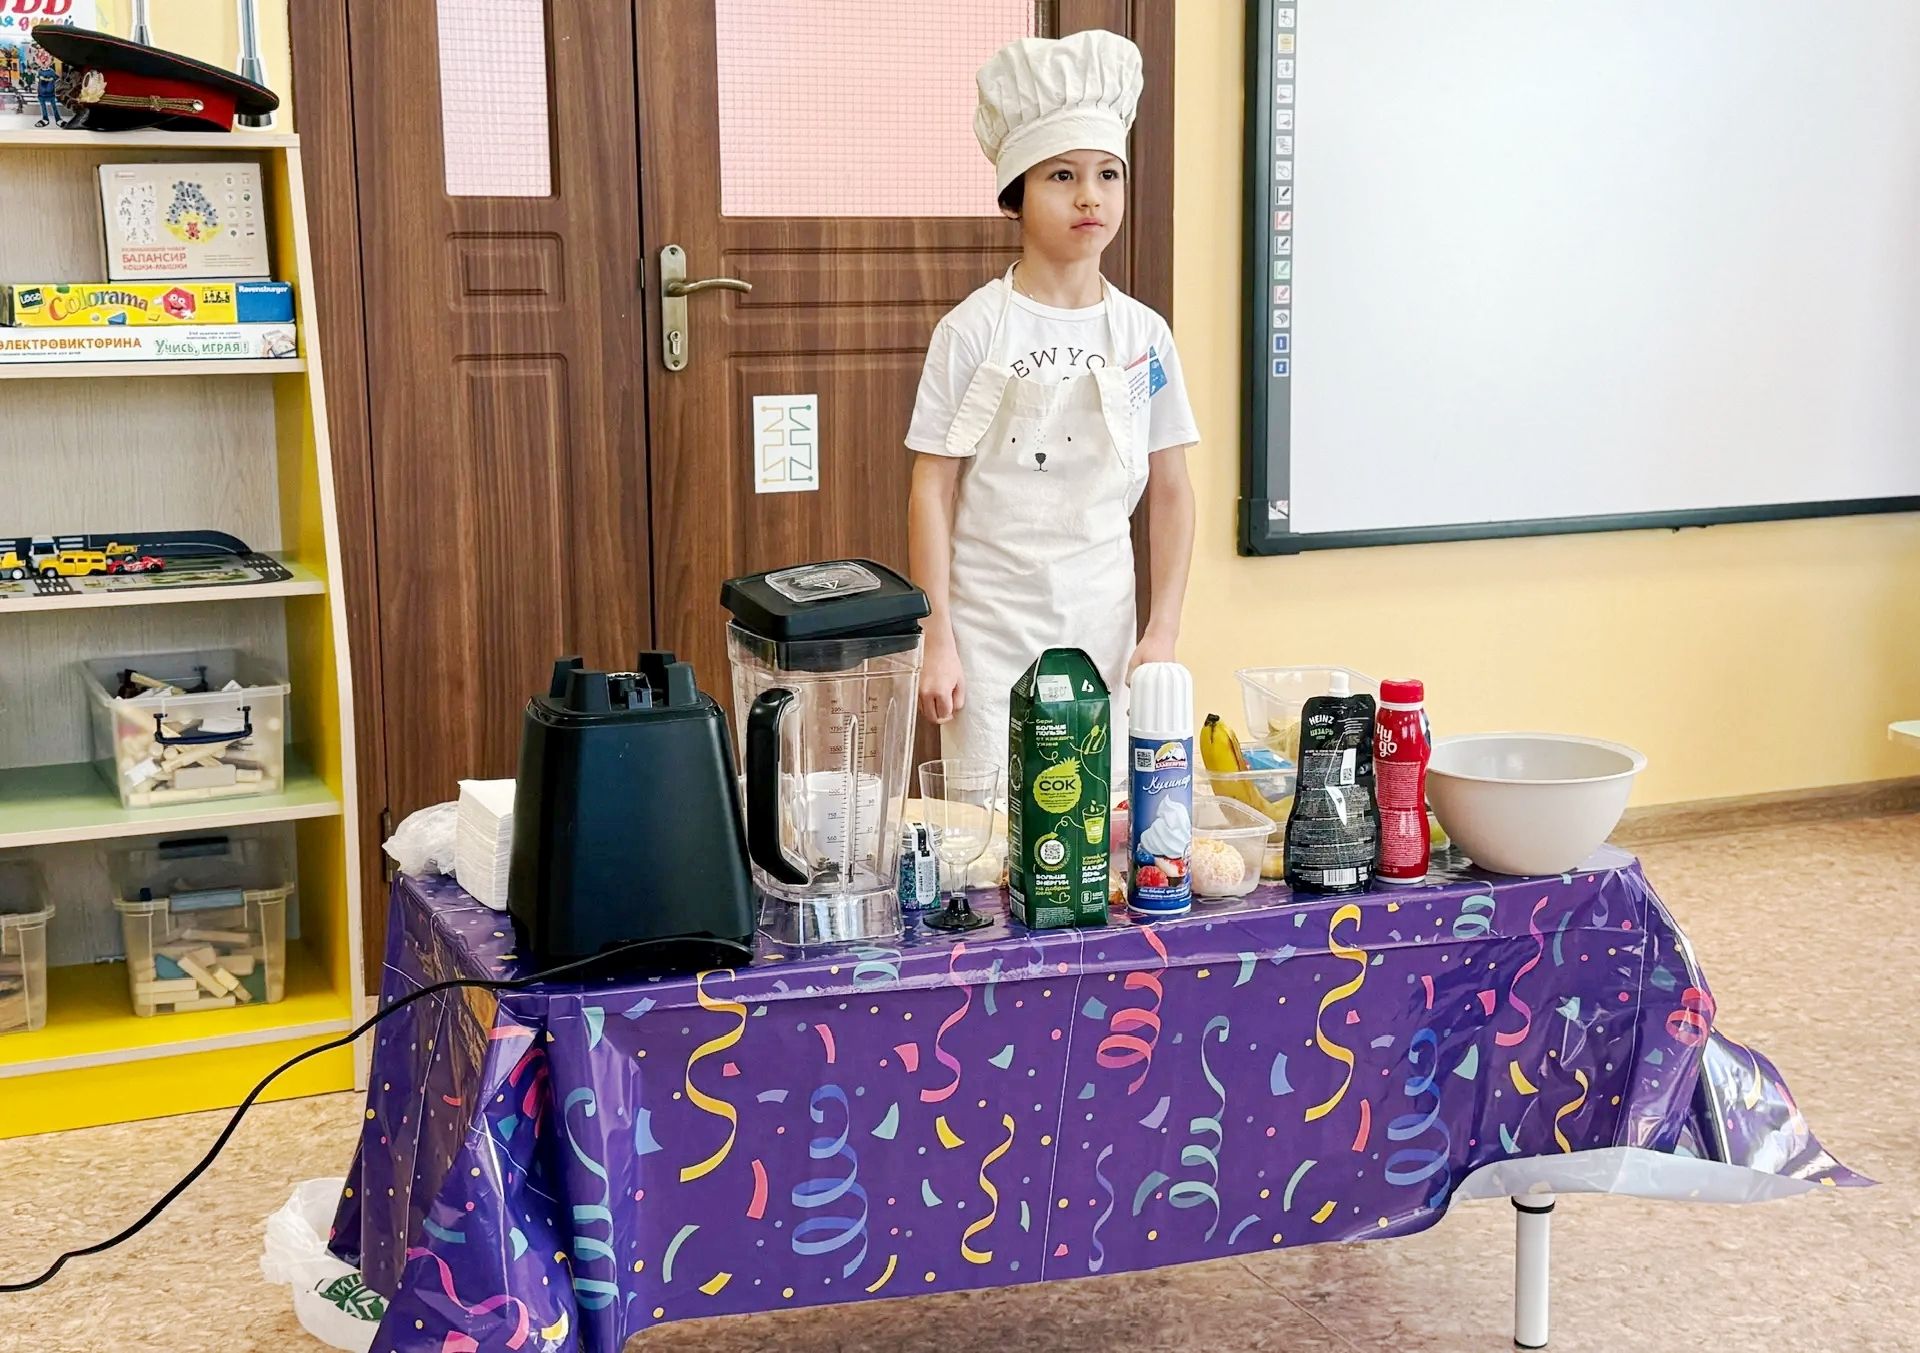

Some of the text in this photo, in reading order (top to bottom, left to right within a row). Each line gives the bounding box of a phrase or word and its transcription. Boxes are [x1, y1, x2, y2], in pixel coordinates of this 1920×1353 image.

[122, 252, 187, 264] БАЛАНСИР
[238, 285, 289, 295] Ravensburger
[48, 287, 149, 321] Colorama
[1308, 714, 1335, 726] HEINZ
[1039, 779, 1076, 791] СОК
